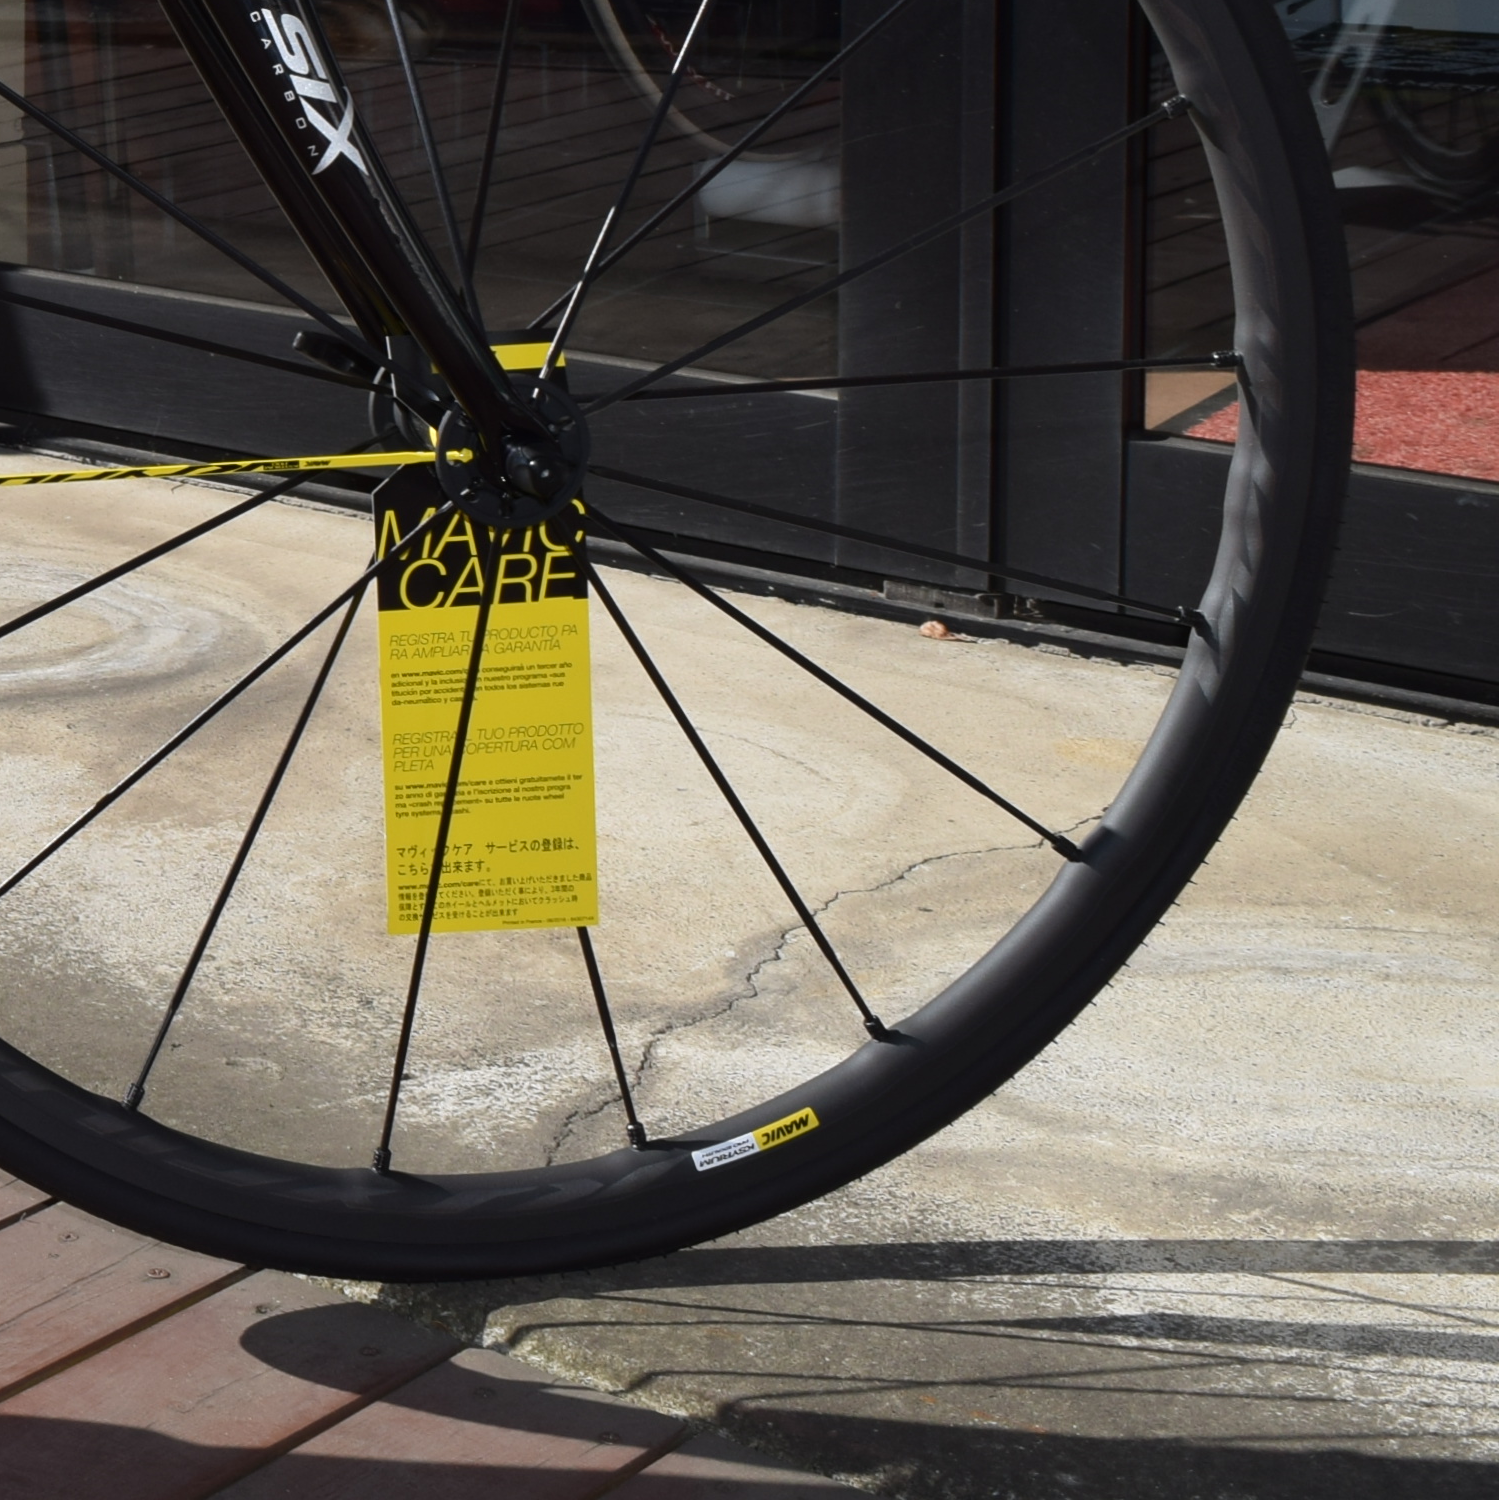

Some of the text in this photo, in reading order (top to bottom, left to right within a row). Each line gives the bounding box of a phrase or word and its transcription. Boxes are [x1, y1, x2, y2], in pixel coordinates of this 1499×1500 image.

[249, 9, 321, 158] CARBON
[399, 551, 576, 610] CARE
[389, 632, 454, 647] REGISTRA
[561, 624, 578, 636] PA
[389, 645, 469, 660] RA AMPLIAR
[391, 673, 548, 687] adicional nuestro programa
[484, 683, 505, 691] todos
[476, 727, 505, 741] TUO
[508, 723, 584, 739] PRODOTTO
[393, 747, 419, 759] PER
[423, 744, 452, 758] UNA
[542, 737, 576, 750] COM
[393, 759, 435, 772] PLETA
[547, 784, 571, 793] progra
[485, 838, 580, 854] サービスの登録は、
[397, 859, 492, 876] こちら出来ます。
[761, 1113, 809, 1146] MAVIC
[699, 1143, 755, 1167] KSYRIUM
